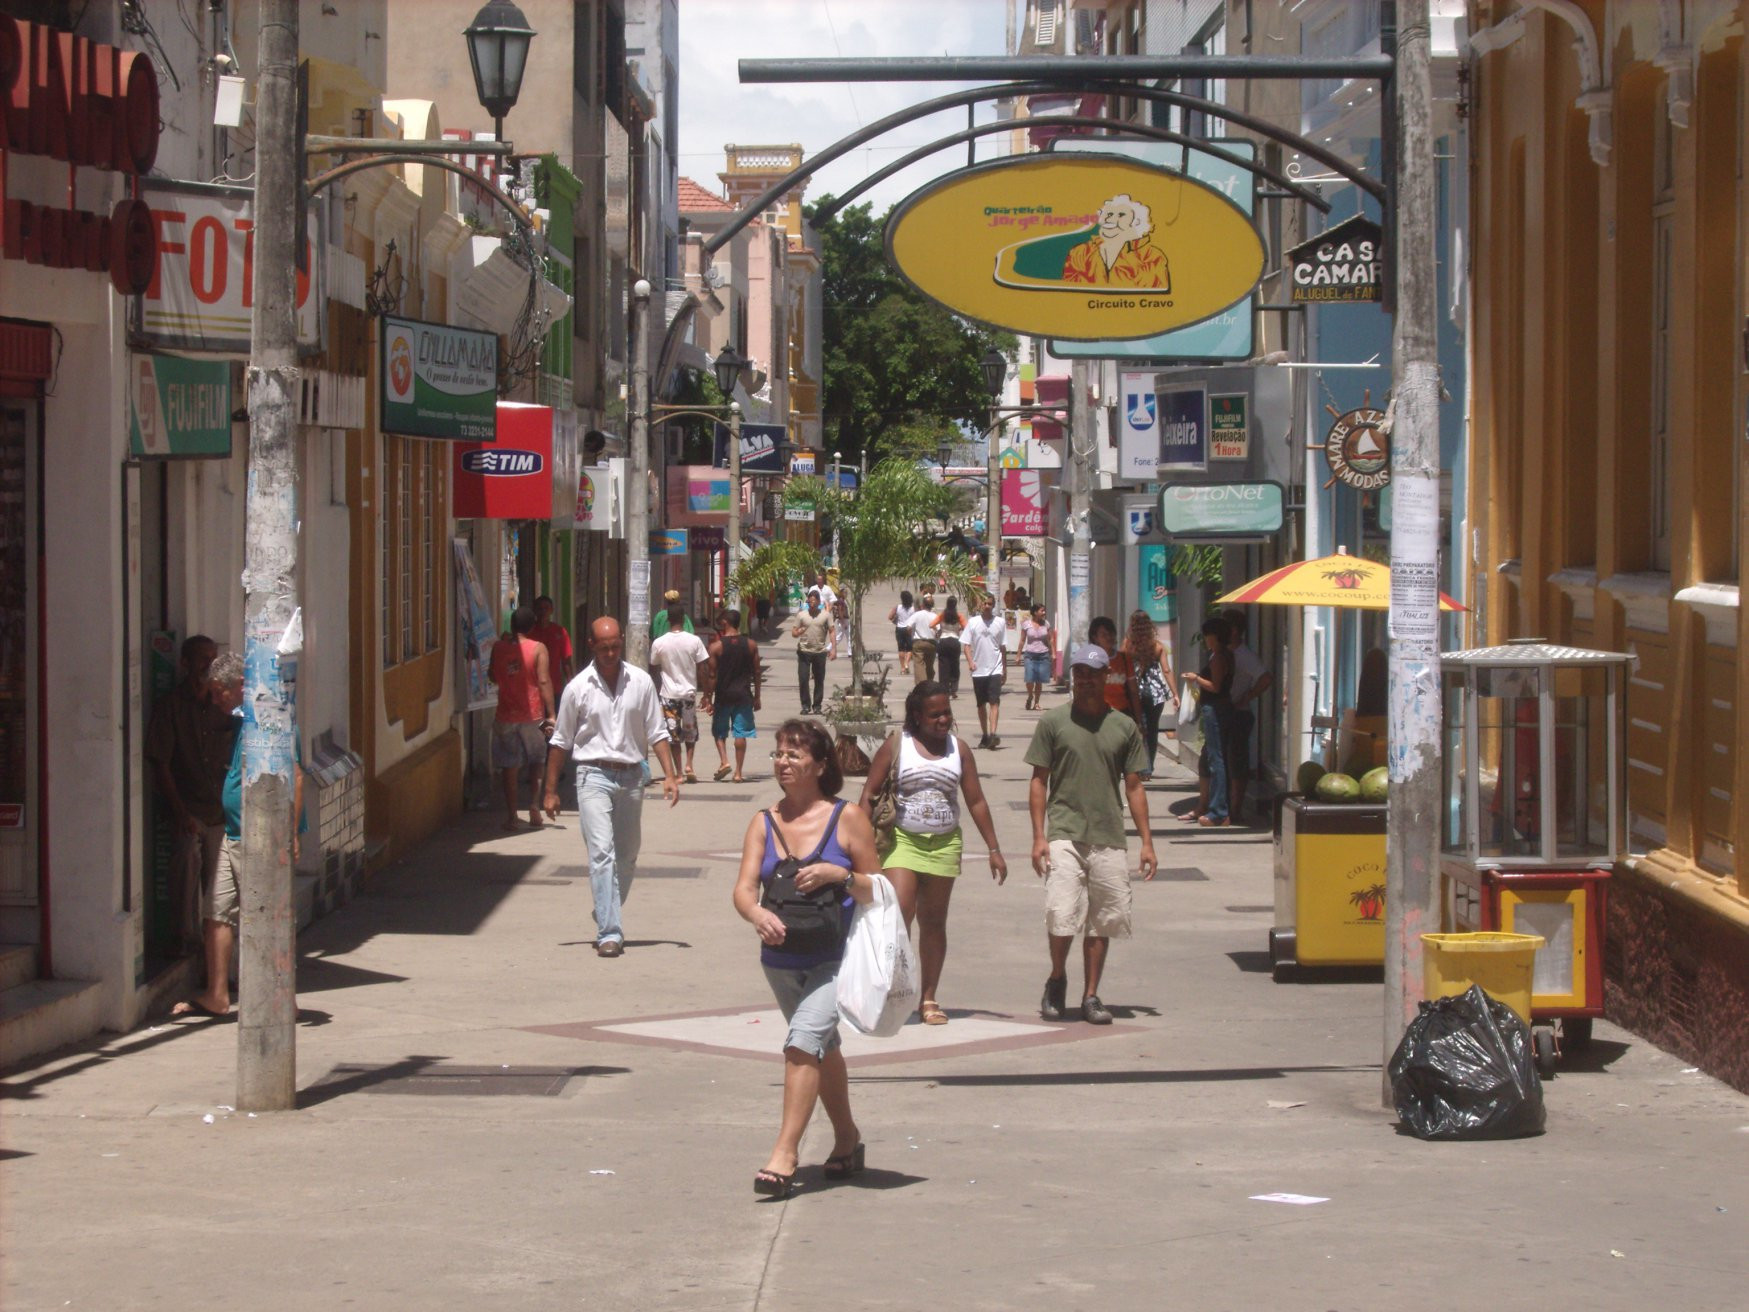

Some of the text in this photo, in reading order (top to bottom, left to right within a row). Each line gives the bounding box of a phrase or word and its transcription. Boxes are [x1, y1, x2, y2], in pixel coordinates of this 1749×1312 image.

[1294, 287, 1341, 300] ALUGUEL
[1087, 298, 1174, 309] Circuito Cravo
[167, 383, 227, 432] FUJIFILM
[1211, 430, 1247, 443] Revelação
[1215, 443, 1242, 456] 1 Hora
[499, 454, 534, 471] TIM
[1134, 457, 1152, 466] Fone:
[1340, 466, 1389, 489] MODAS
[690, 533, 719, 545] vivo
